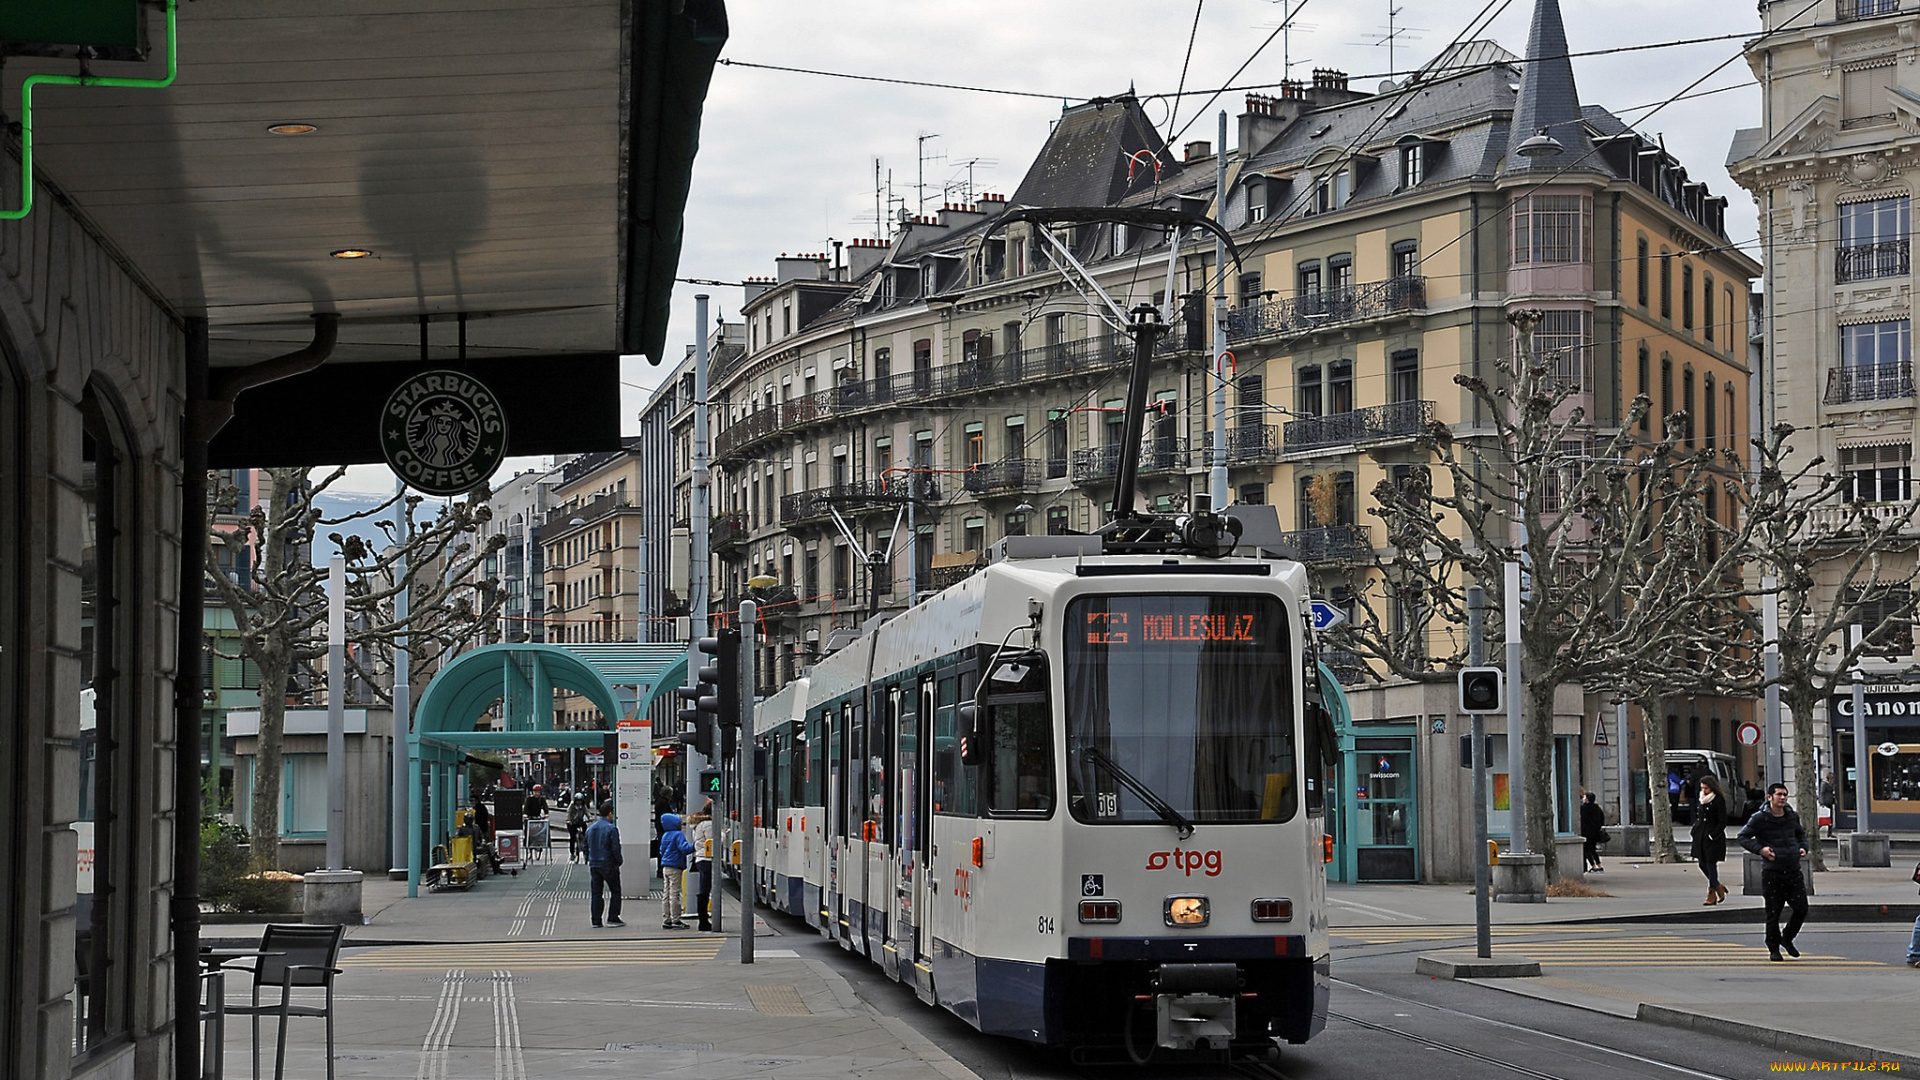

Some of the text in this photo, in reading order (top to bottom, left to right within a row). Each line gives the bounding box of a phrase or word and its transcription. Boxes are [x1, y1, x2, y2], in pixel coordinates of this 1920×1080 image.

[390, 375, 501, 434] STARBUCKS
[395, 450, 478, 486] COFFEE
[1143, 614, 1253, 640] MOILLESULAZ
[1838, 699, 1920, 716] Canon
[1174, 847, 1222, 876] tpg
[1039, 916, 1054, 934] 814
